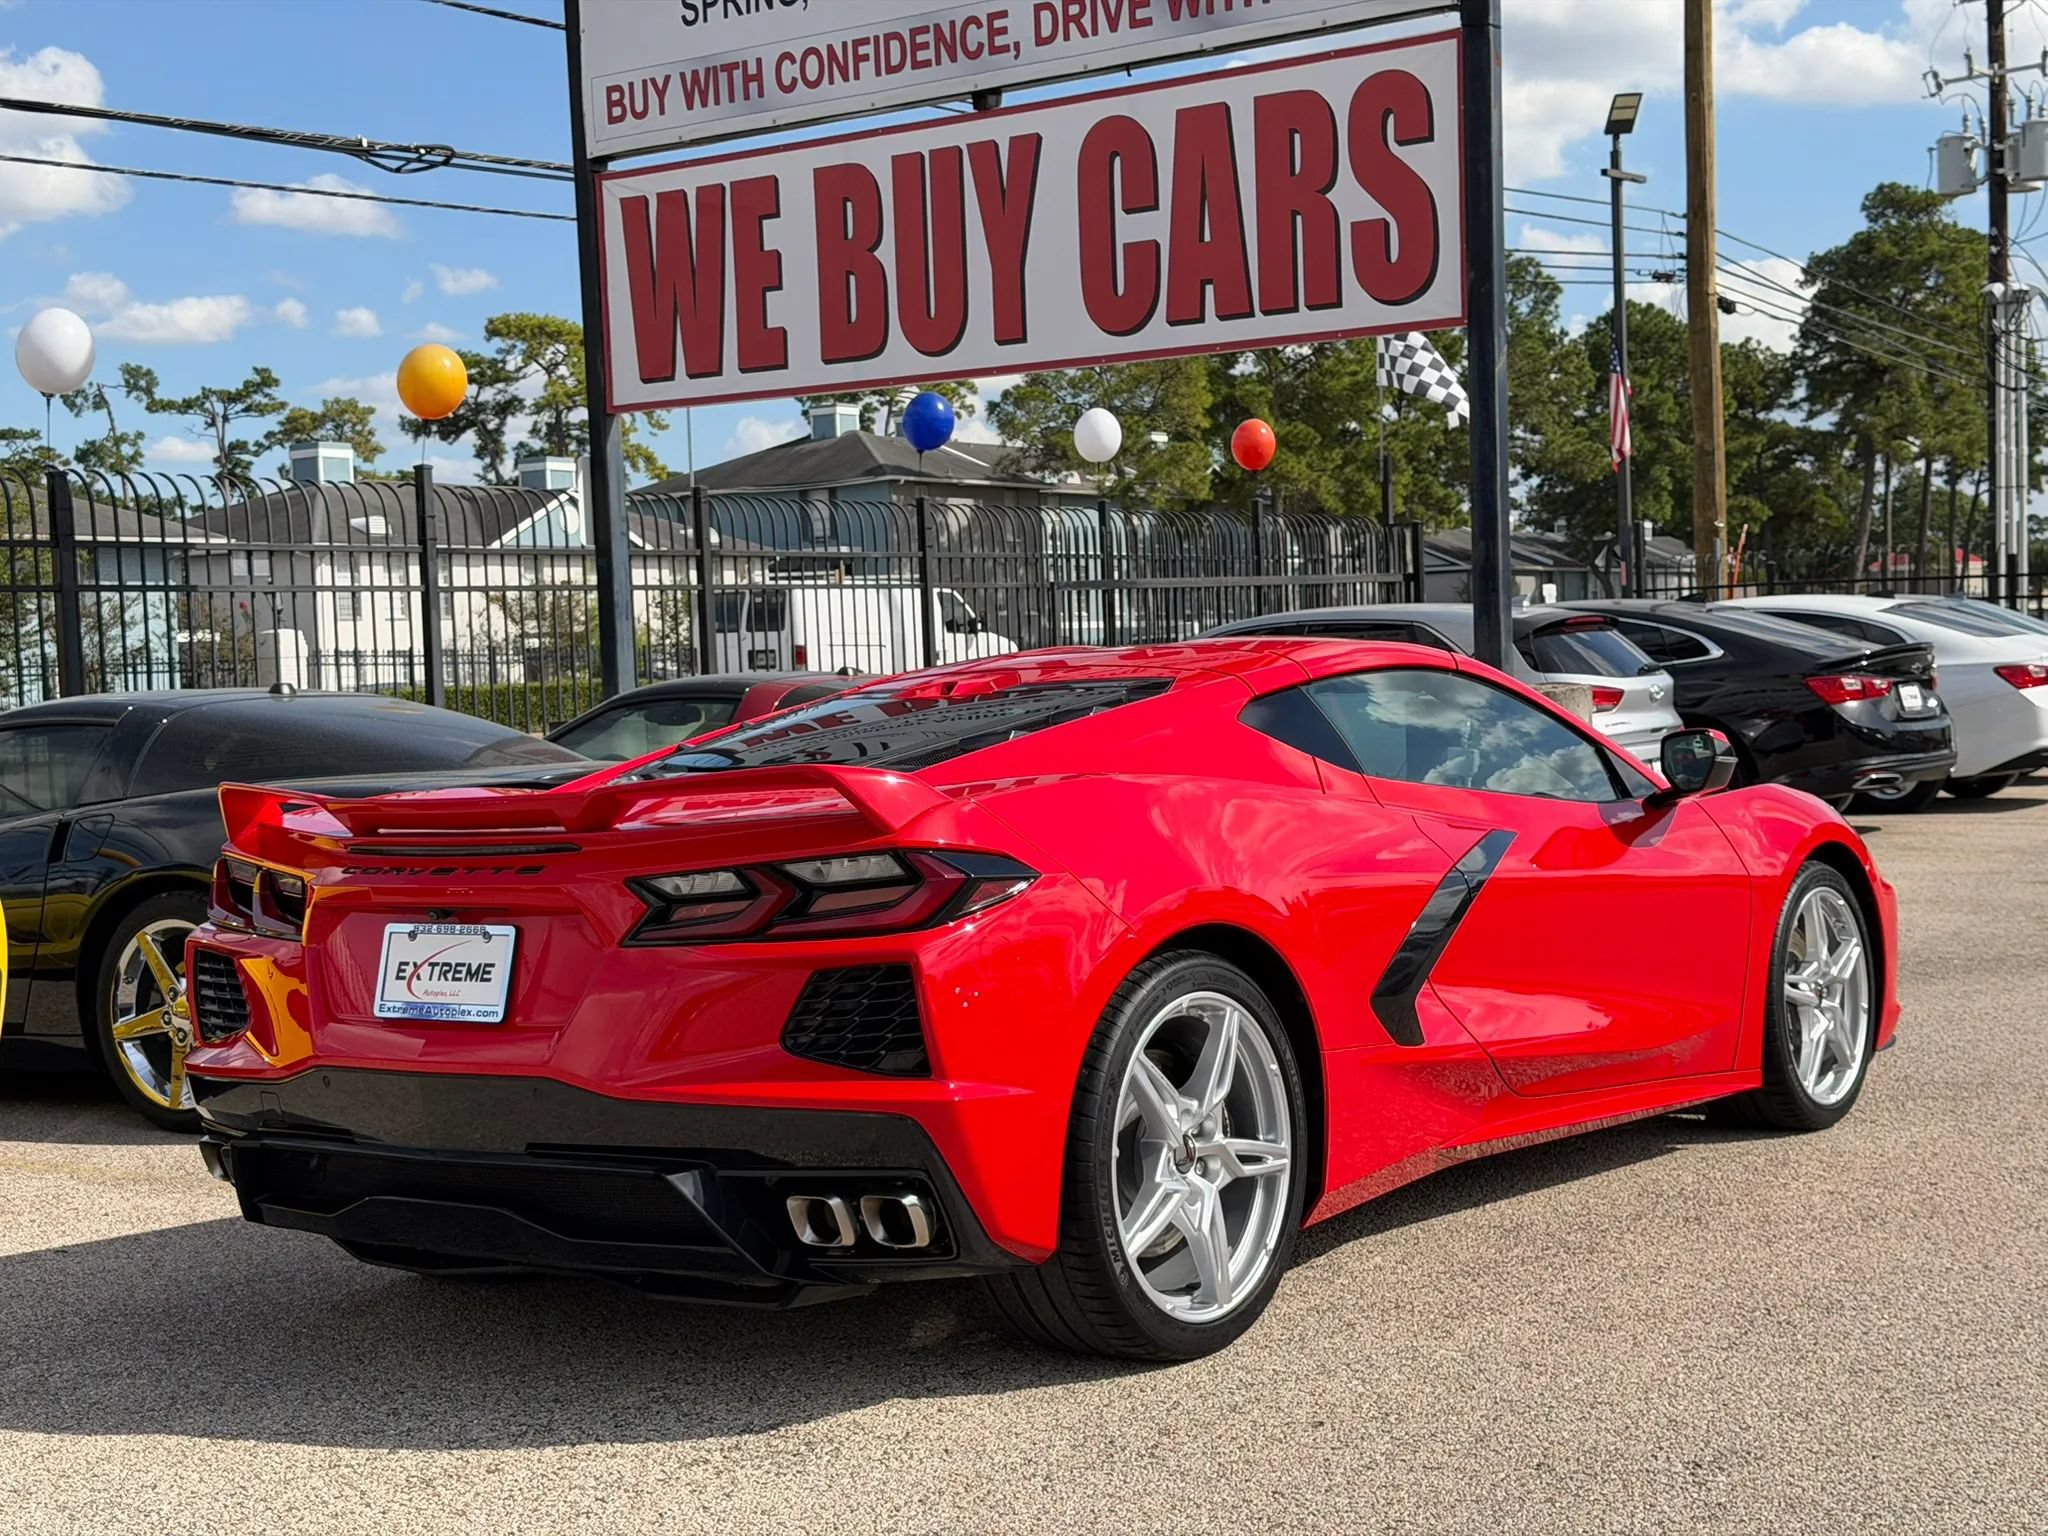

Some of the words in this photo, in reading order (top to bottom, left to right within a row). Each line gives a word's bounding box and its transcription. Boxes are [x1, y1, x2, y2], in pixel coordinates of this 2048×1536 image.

[605, 74, 671, 125] BUY
[679, 57, 764, 110] WITH
[775, 10, 1021, 94] CONFIDENCE,
[1033, 0, 1153, 47] DRIVE
[619, 174, 788, 384] WE
[813, 131, 1042, 365] BUY
[1077, 69, 1440, 337] CARS
[341, 866, 545, 876] CORVETTE
[395, 961, 496, 983] EXTREME
[379, 1003, 499, 1018] ExtremeAutoplex.com
